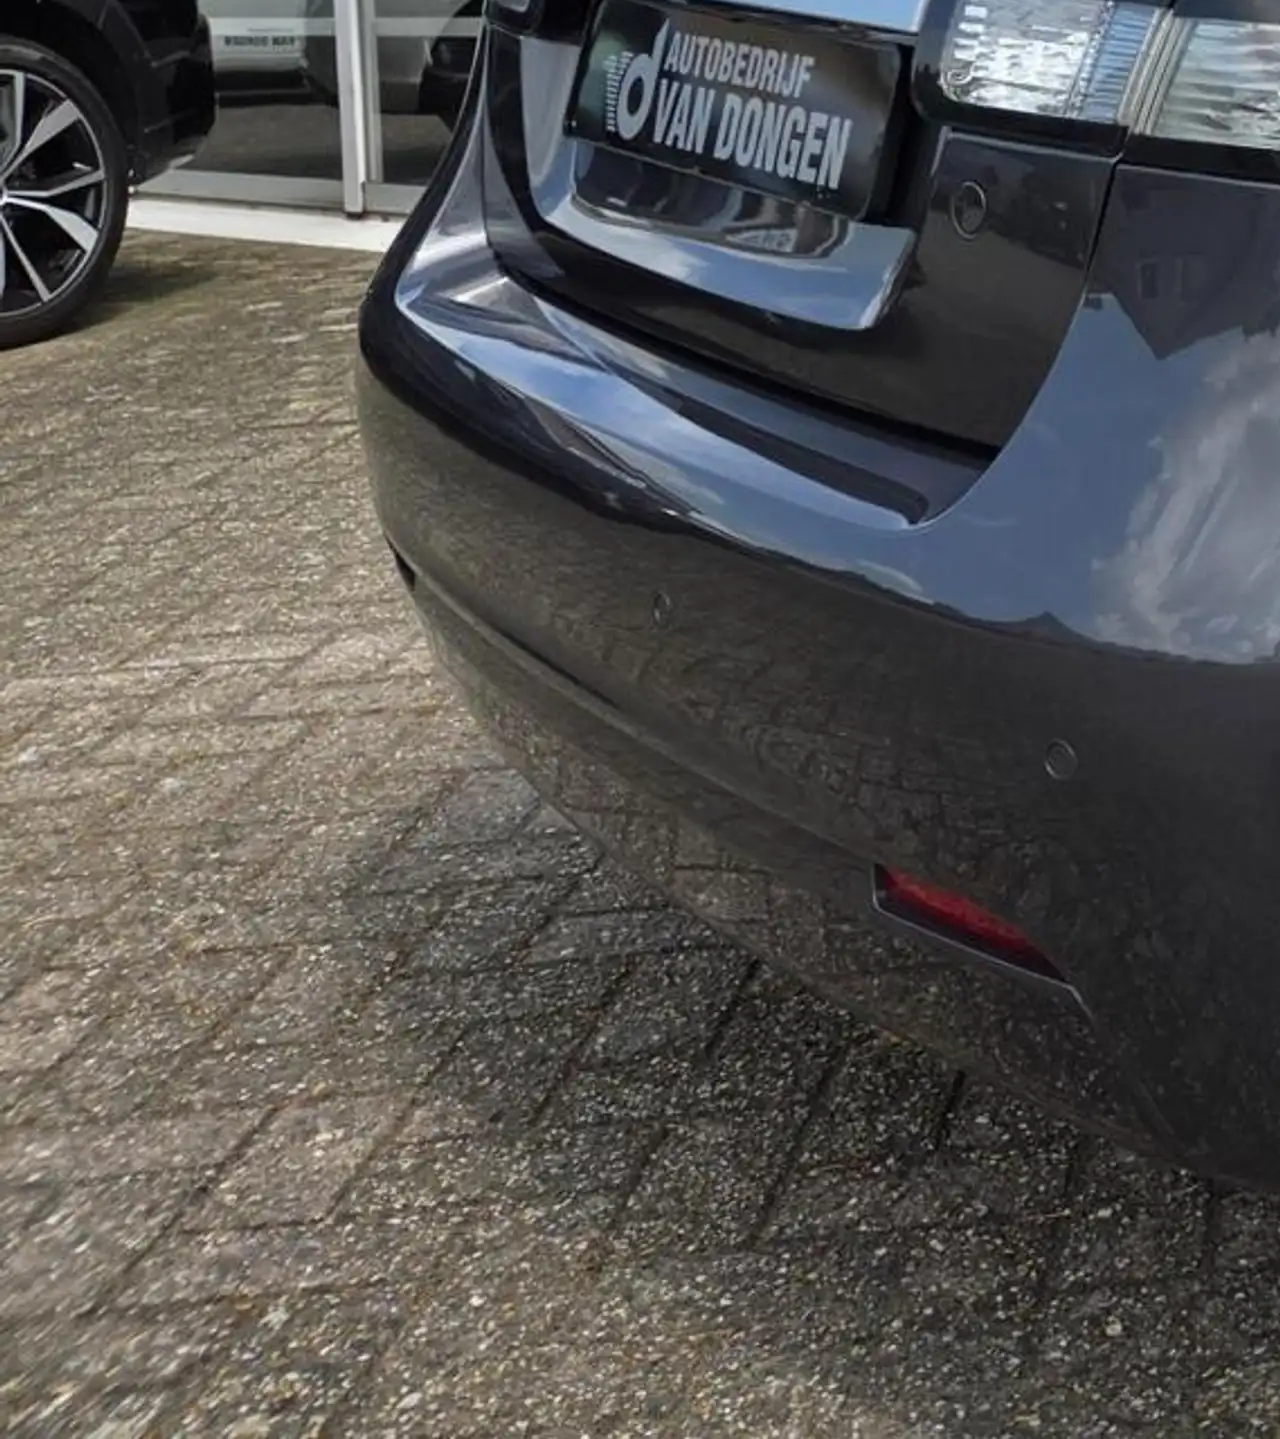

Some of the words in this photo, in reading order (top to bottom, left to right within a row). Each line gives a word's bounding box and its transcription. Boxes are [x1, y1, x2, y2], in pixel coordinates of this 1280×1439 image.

[664, 32, 815, 98] AUTOBEDRIJF
[653, 79, 716, 154] VAN
[713, 91, 853, 190] DONGEN
